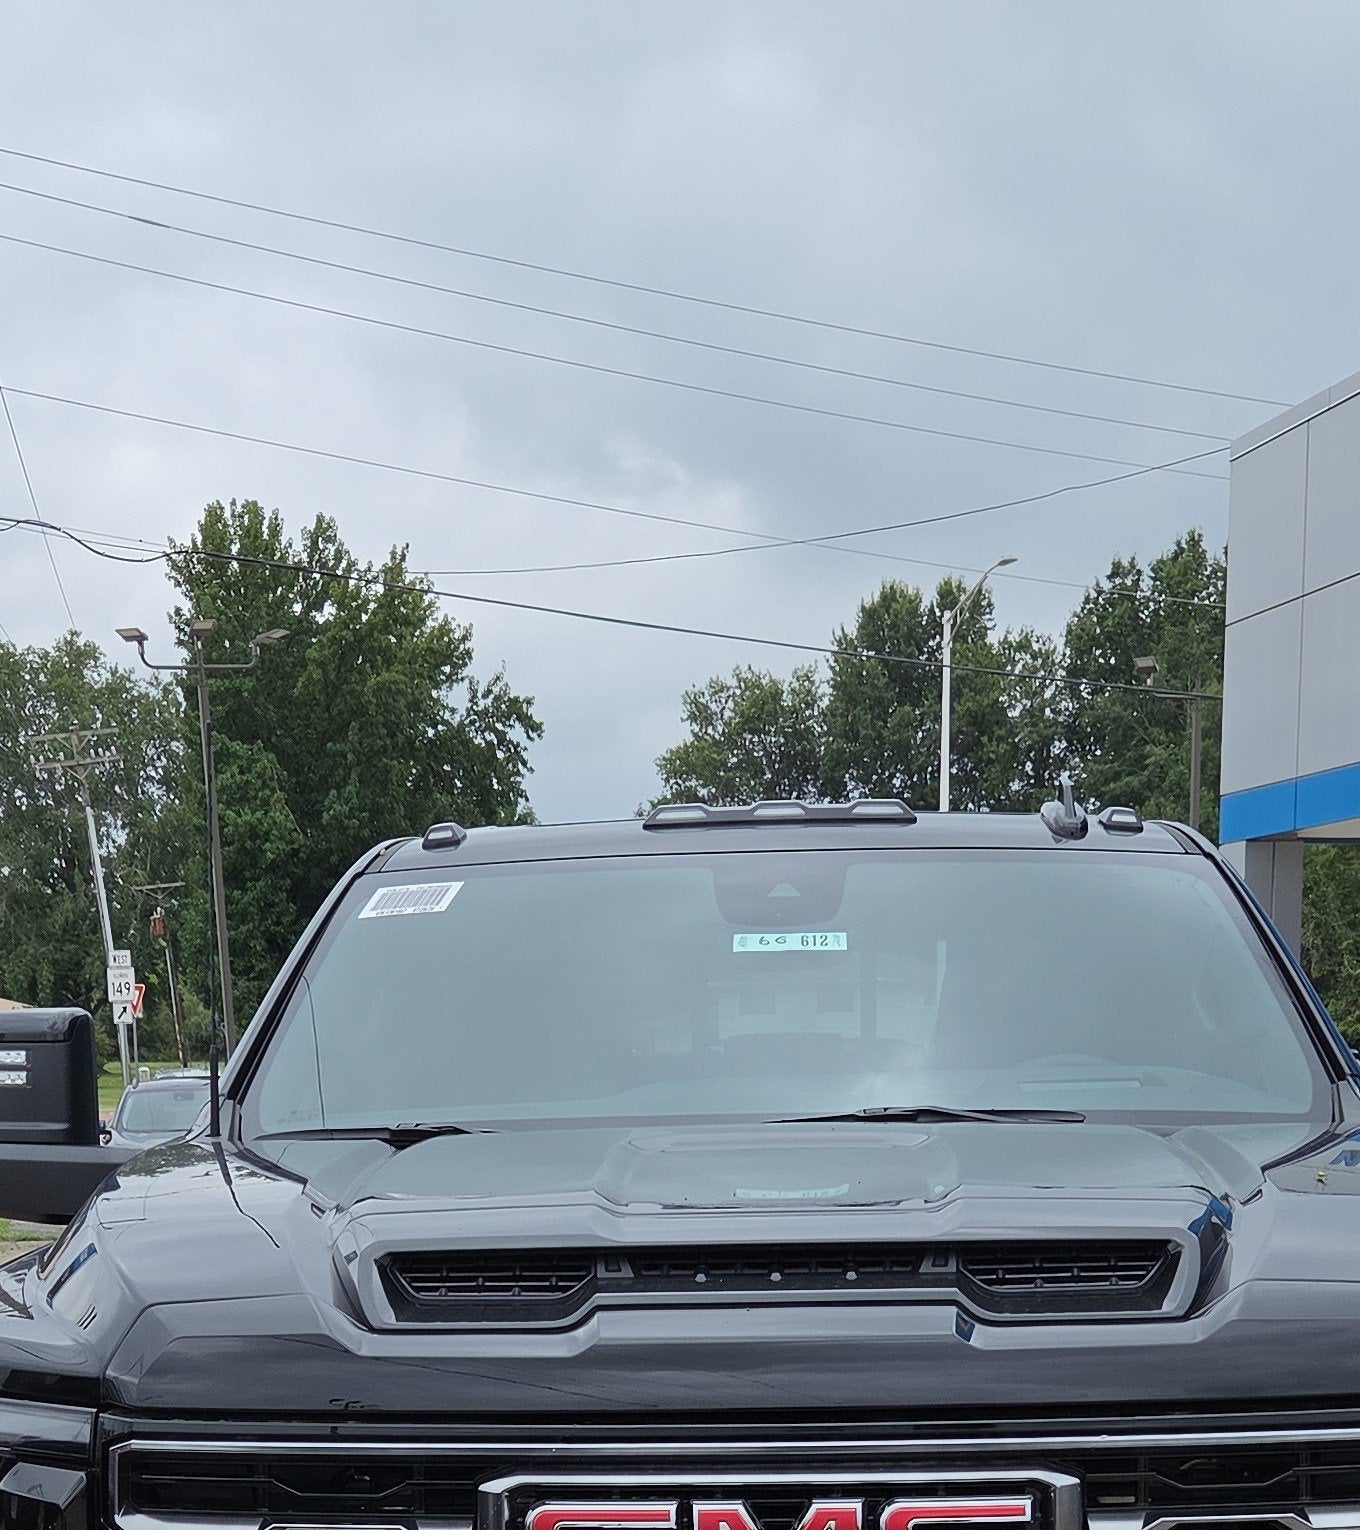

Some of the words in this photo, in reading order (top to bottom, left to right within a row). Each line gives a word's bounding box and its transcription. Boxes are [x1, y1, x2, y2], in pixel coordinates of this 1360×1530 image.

[801, 935, 829, 946] 612
[112, 955, 127, 964] WEST
[112, 982, 130, 997] 149
